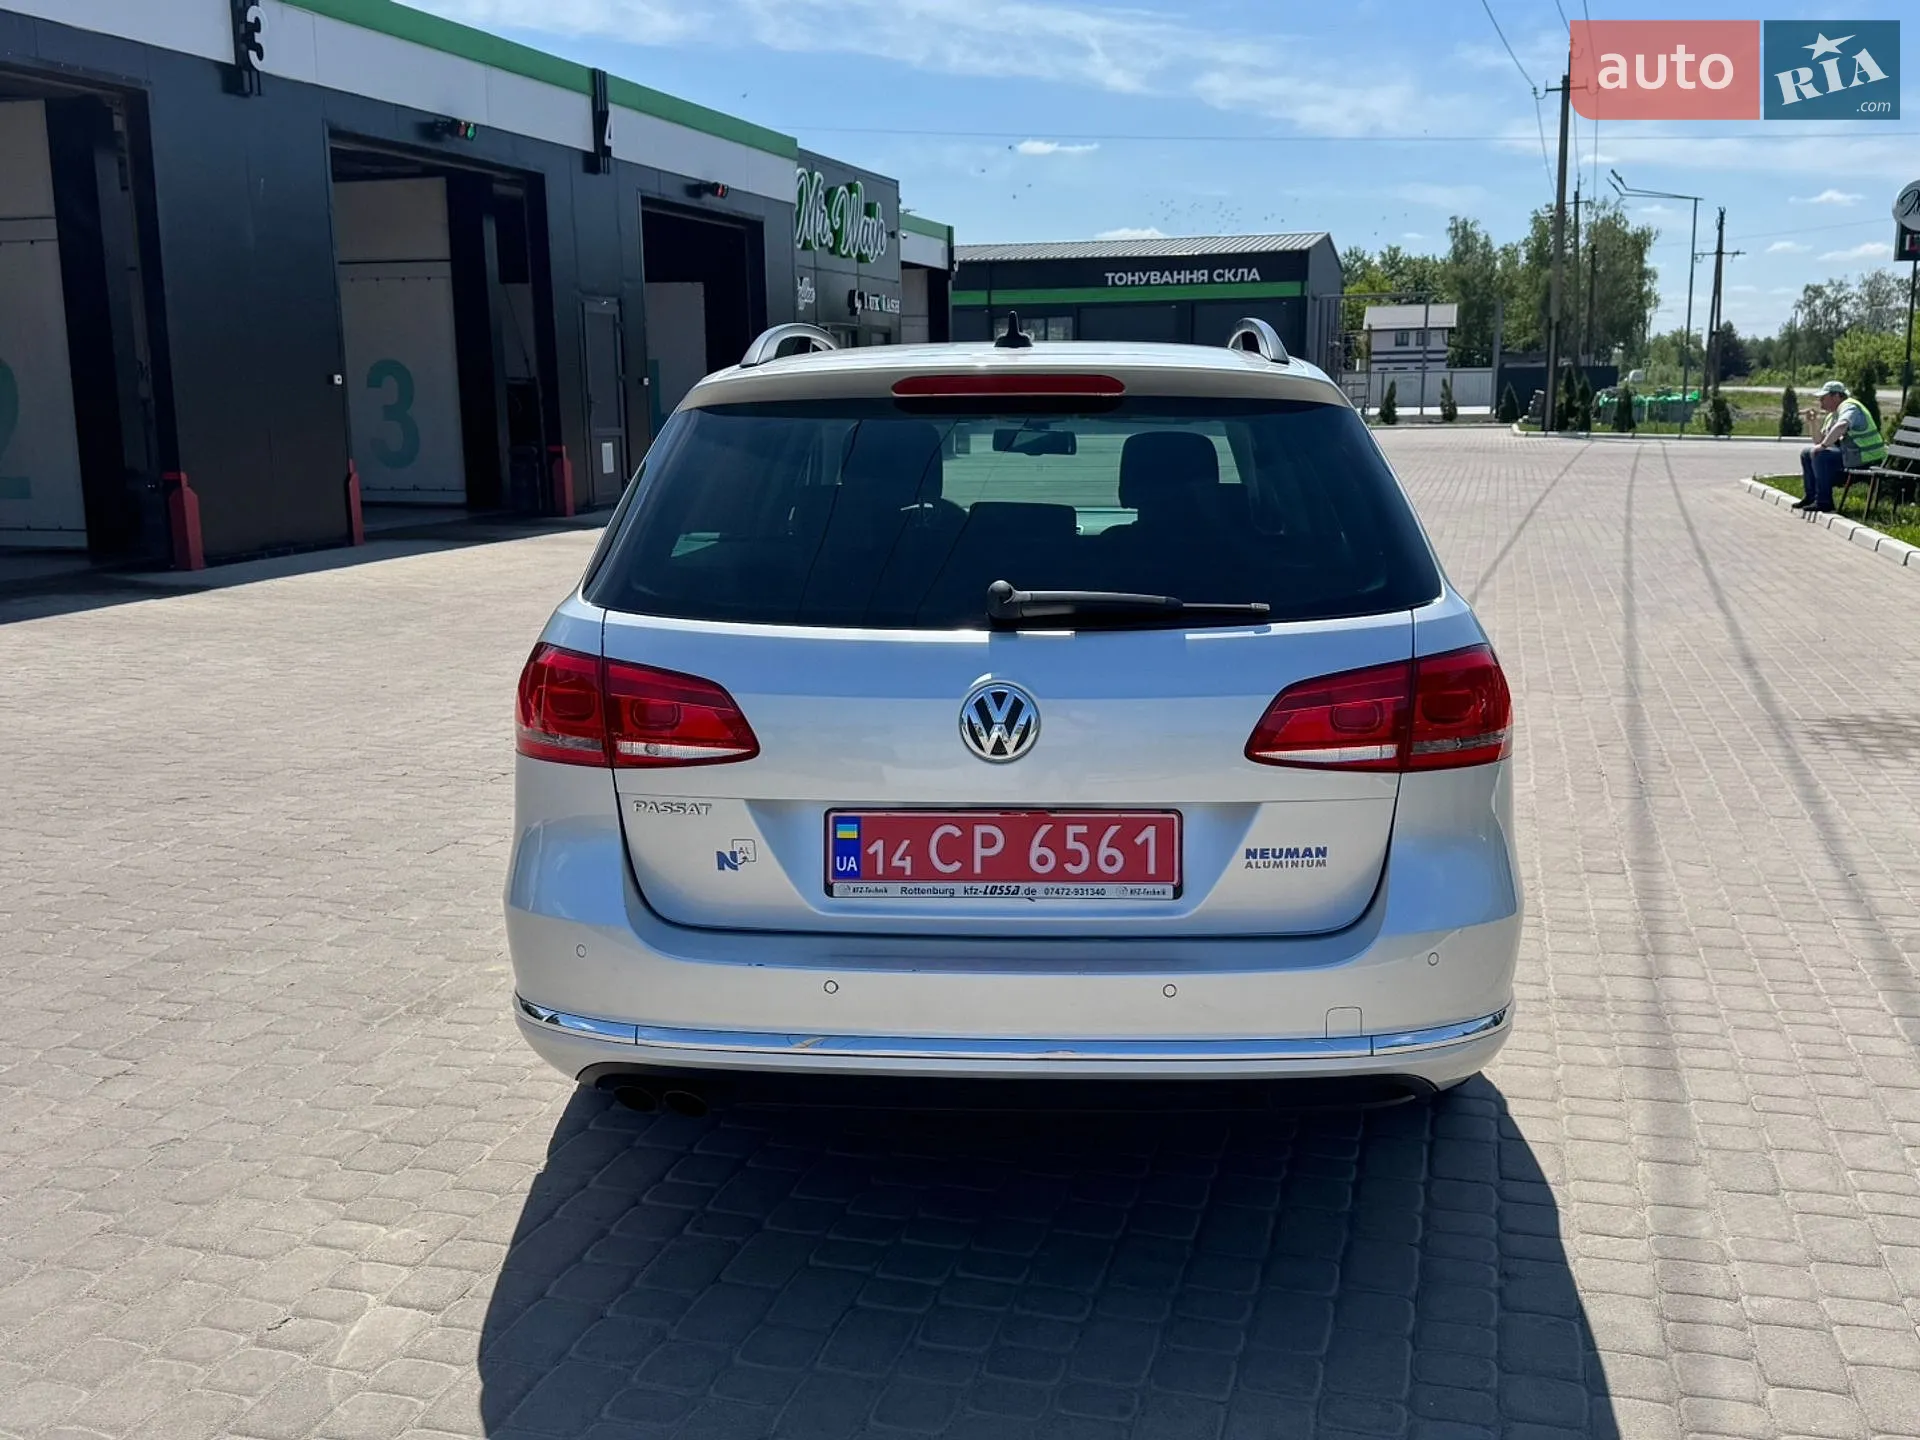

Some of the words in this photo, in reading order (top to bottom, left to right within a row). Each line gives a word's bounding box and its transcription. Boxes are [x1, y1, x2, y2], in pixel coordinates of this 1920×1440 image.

[247, 5, 268, 72] 3
[795, 168, 834, 250] Mr.
[831, 181, 887, 264] Wash
[1105, 268, 1209, 287] ТОНУВАННЯ
[1213, 267, 1261, 283] СКЛА
[366, 358, 420, 469] 3
[633, 800, 712, 817] PASSAT
[836, 856, 858, 872] UA
[867, 838, 912, 875] 14
[928, 824, 1006, 875] CP
[1028, 824, 1157, 875] 6561
[1245, 846, 1328, 860] NEUMAN
[1244, 859, 1327, 870] ALUMINIUM
[900, 886, 955, 897] Rottenburg
[1044, 887, 1107, 897] 07472-931340
